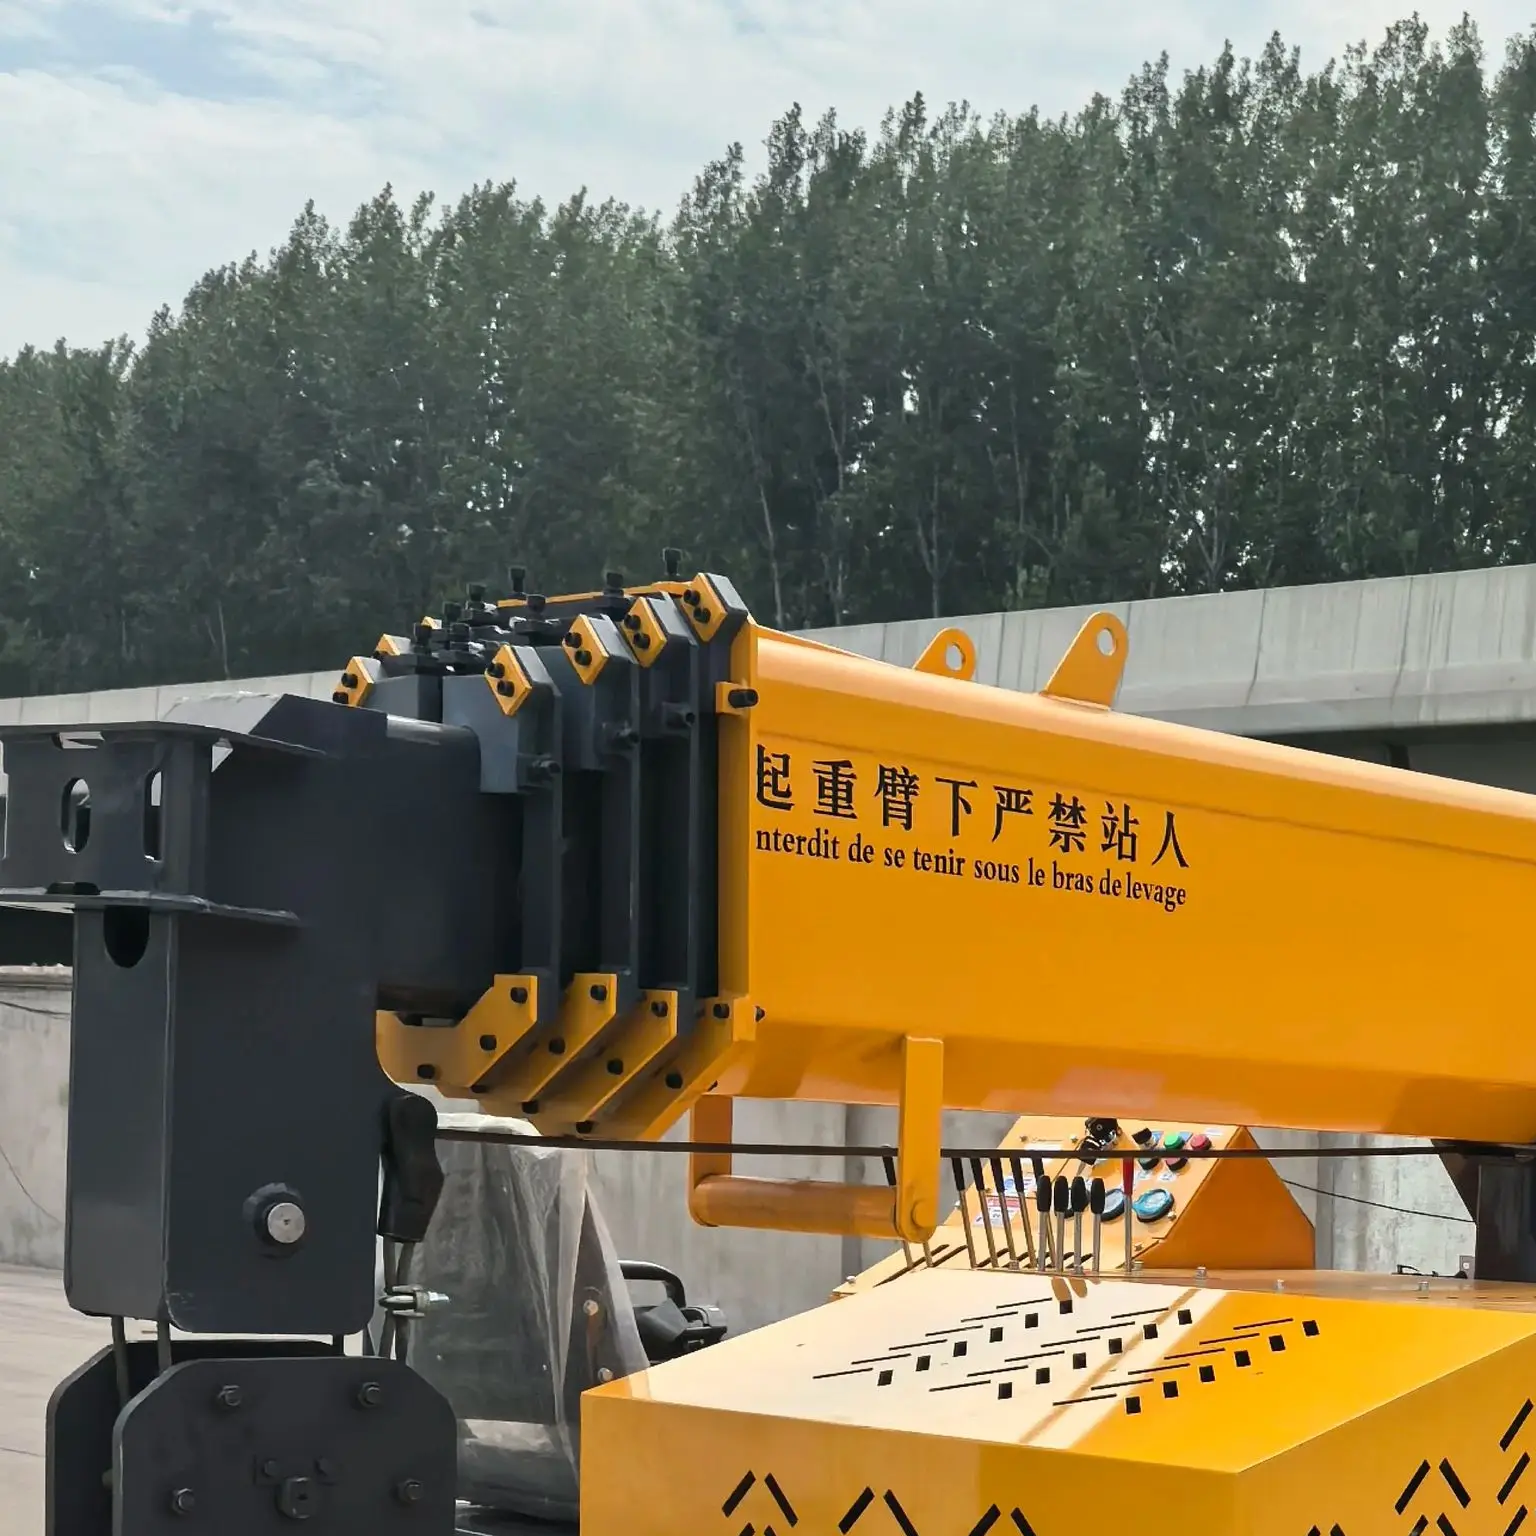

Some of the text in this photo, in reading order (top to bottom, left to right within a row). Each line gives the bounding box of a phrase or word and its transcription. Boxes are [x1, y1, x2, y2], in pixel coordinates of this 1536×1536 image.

[756, 743, 1189, 868] 起重臂下严禁站人
[756, 827, 1186, 913] nterdit de se tenir sous le bras de levage
